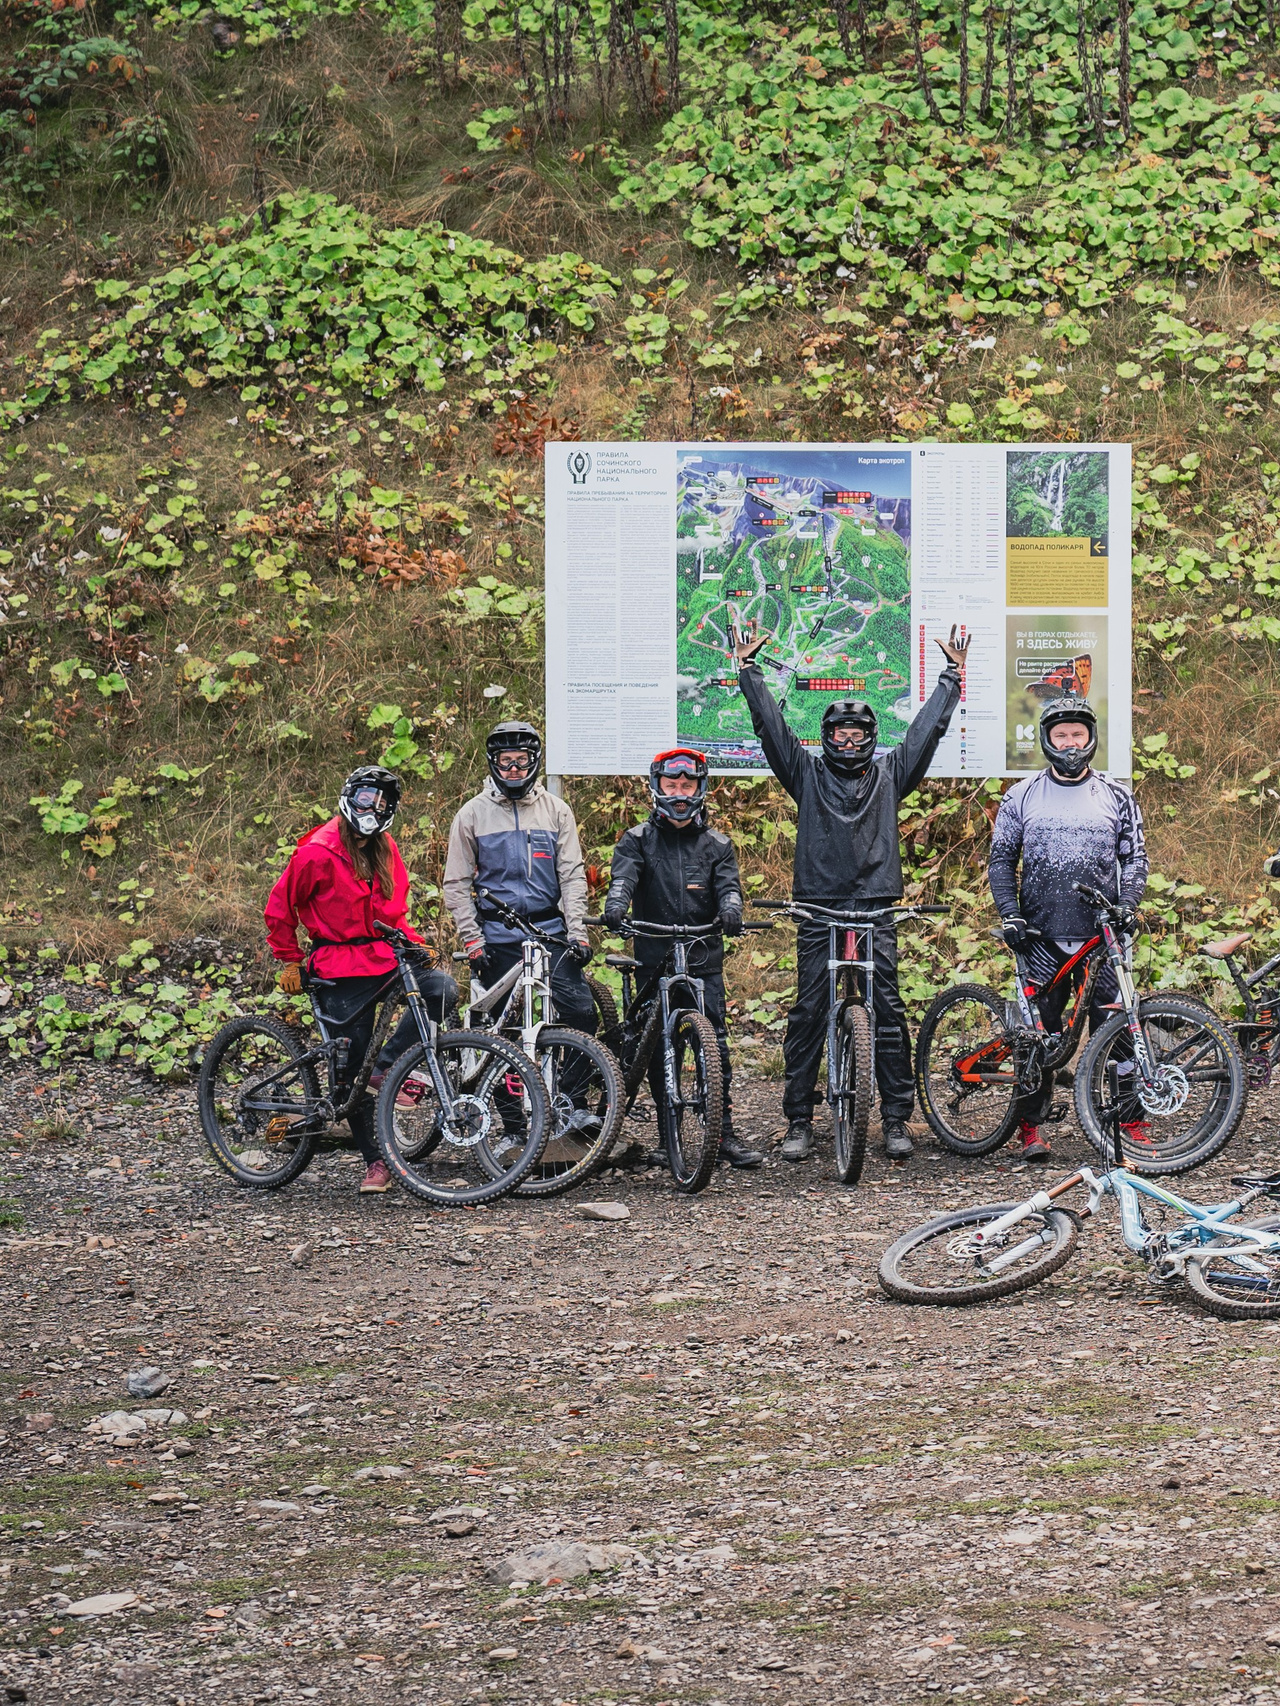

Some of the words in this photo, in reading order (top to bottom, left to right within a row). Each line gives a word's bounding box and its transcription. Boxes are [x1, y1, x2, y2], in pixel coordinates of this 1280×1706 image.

[858, 457, 877, 465] Карта
[1016, 639, 1024, 648] Я
[1027, 639, 1063, 650] ЗДЕСЬ
[1065, 639, 1098, 648] ЖИВУ
[1204, 1022, 1233, 1058] MAXXIS
[491, 1043, 527, 1073] MAXXIS
